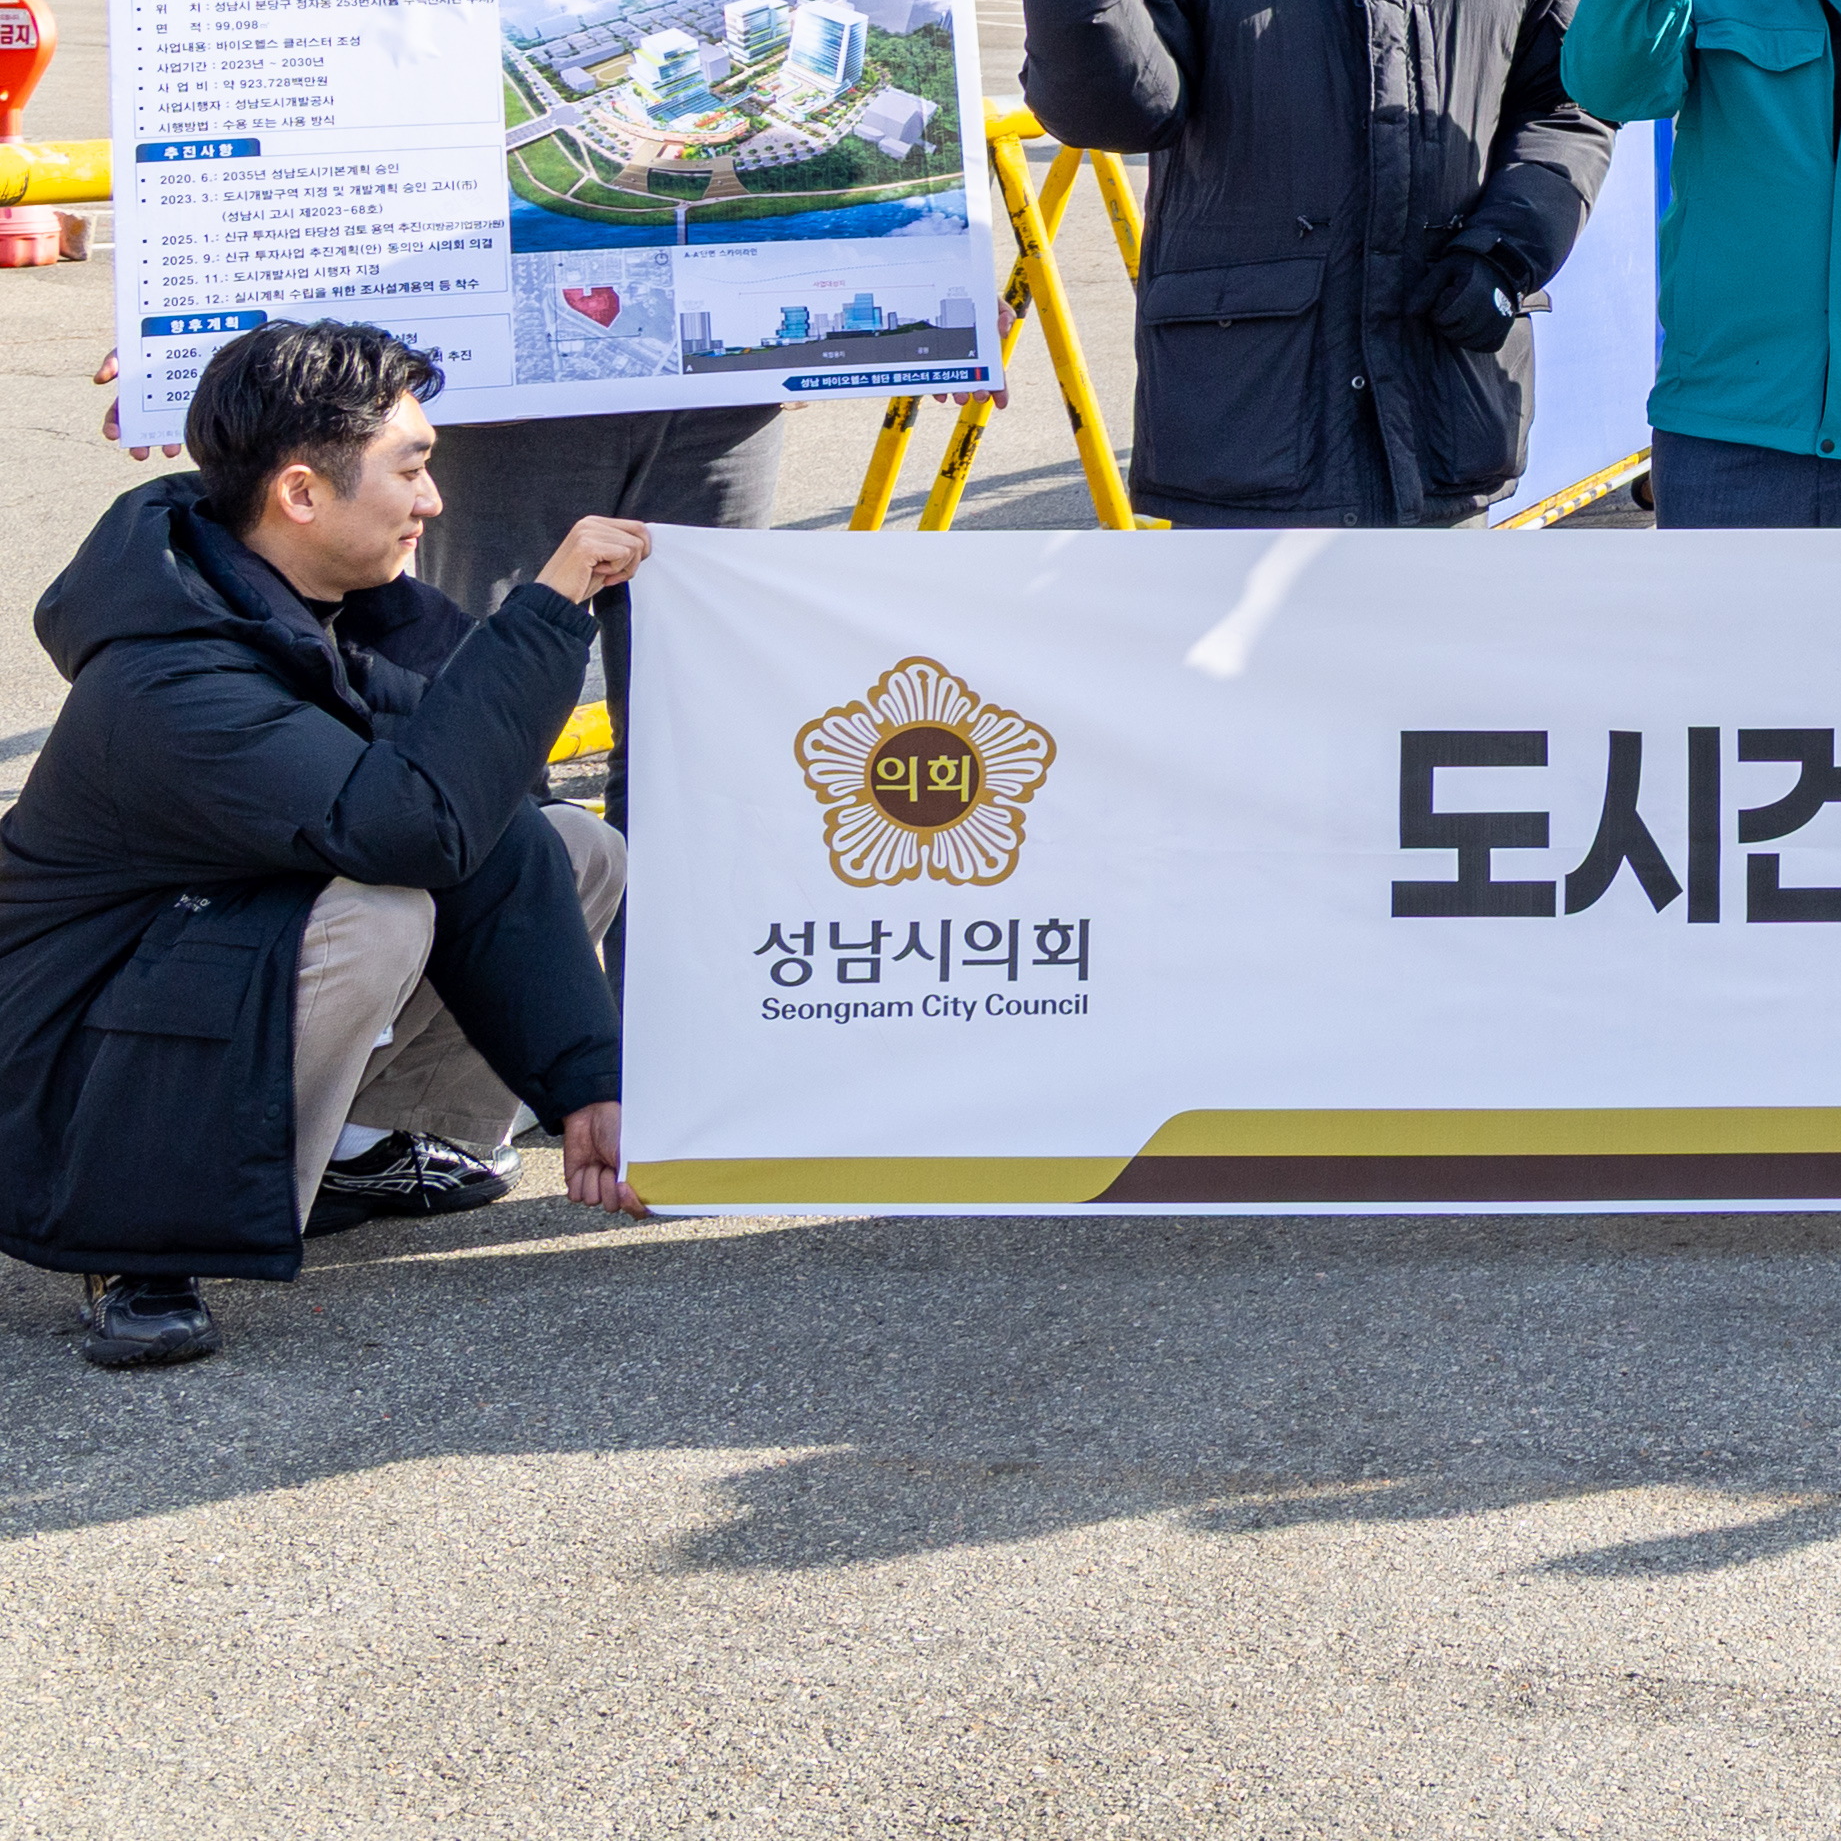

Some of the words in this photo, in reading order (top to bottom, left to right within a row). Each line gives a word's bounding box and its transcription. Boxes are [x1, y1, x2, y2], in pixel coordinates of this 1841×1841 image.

[165, 347, 202, 360] 2026.
[874, 754, 978, 805] 의회
[752, 917, 1092, 988] 성남시의회
[760, 996, 915, 1026] Seongnam
[921, 993, 979, 1023] City
[984, 992, 1090, 1017] Council
